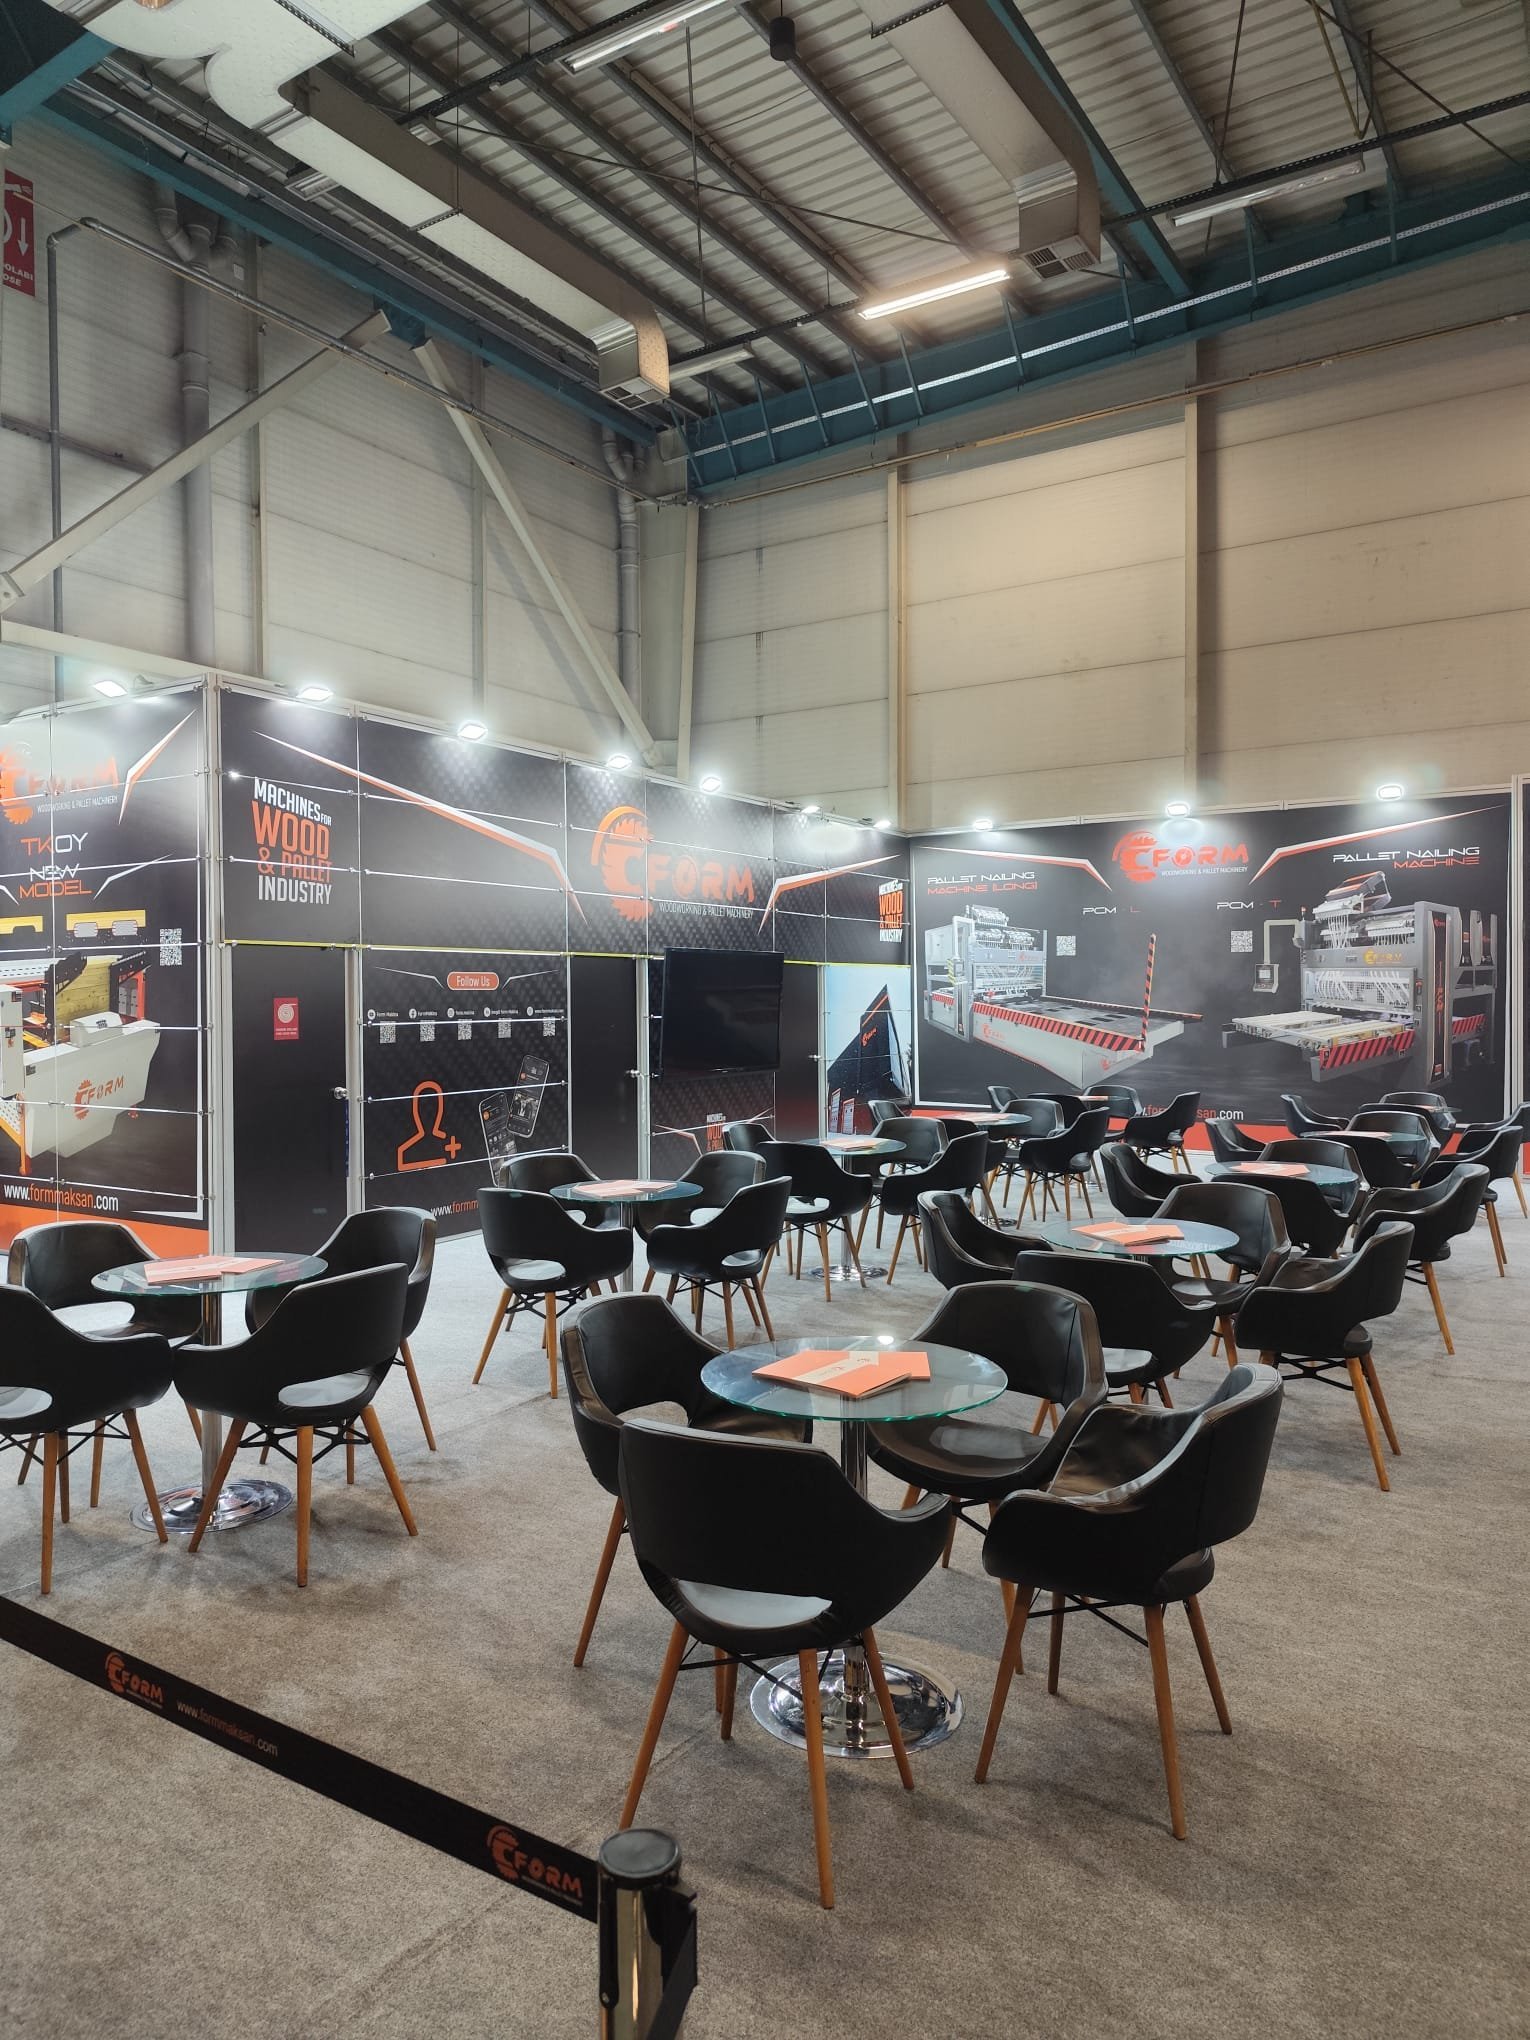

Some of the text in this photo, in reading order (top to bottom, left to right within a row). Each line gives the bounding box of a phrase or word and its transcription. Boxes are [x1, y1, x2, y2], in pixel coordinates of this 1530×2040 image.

[3, 273, 22, 287] OSE
[4, 263, 34, 281] OLABI
[254, 776, 332, 826] MACHINES FOR
[252, 800, 330, 860] WOOD
[1333, 847, 1480, 863] PALLET NAILING
[1393, 856, 1480, 869] MACHINE
[30, 863, 80, 882] NEW
[257, 847, 333, 883] & PALLET
[928, 871, 1035, 884] PALLET NAILING
[19, 880, 93, 899] MODEL
[258, 875, 332, 905] INDUSTRY
[928, 884, 988, 896] MACHINE
[879, 890, 903, 916] WOOD
[1083, 907, 1117, 915] PCM
[1130, 905, 1140, 913] L
[1217, 901, 1254, 910] PCM
[1269, 900, 1281, 908] T
[456, 975, 490, 987] Follow Us
[3, 1183, 119, 1212] www.formmaksan.com
[176, 1700, 278, 1757] www.formmaksan.com
